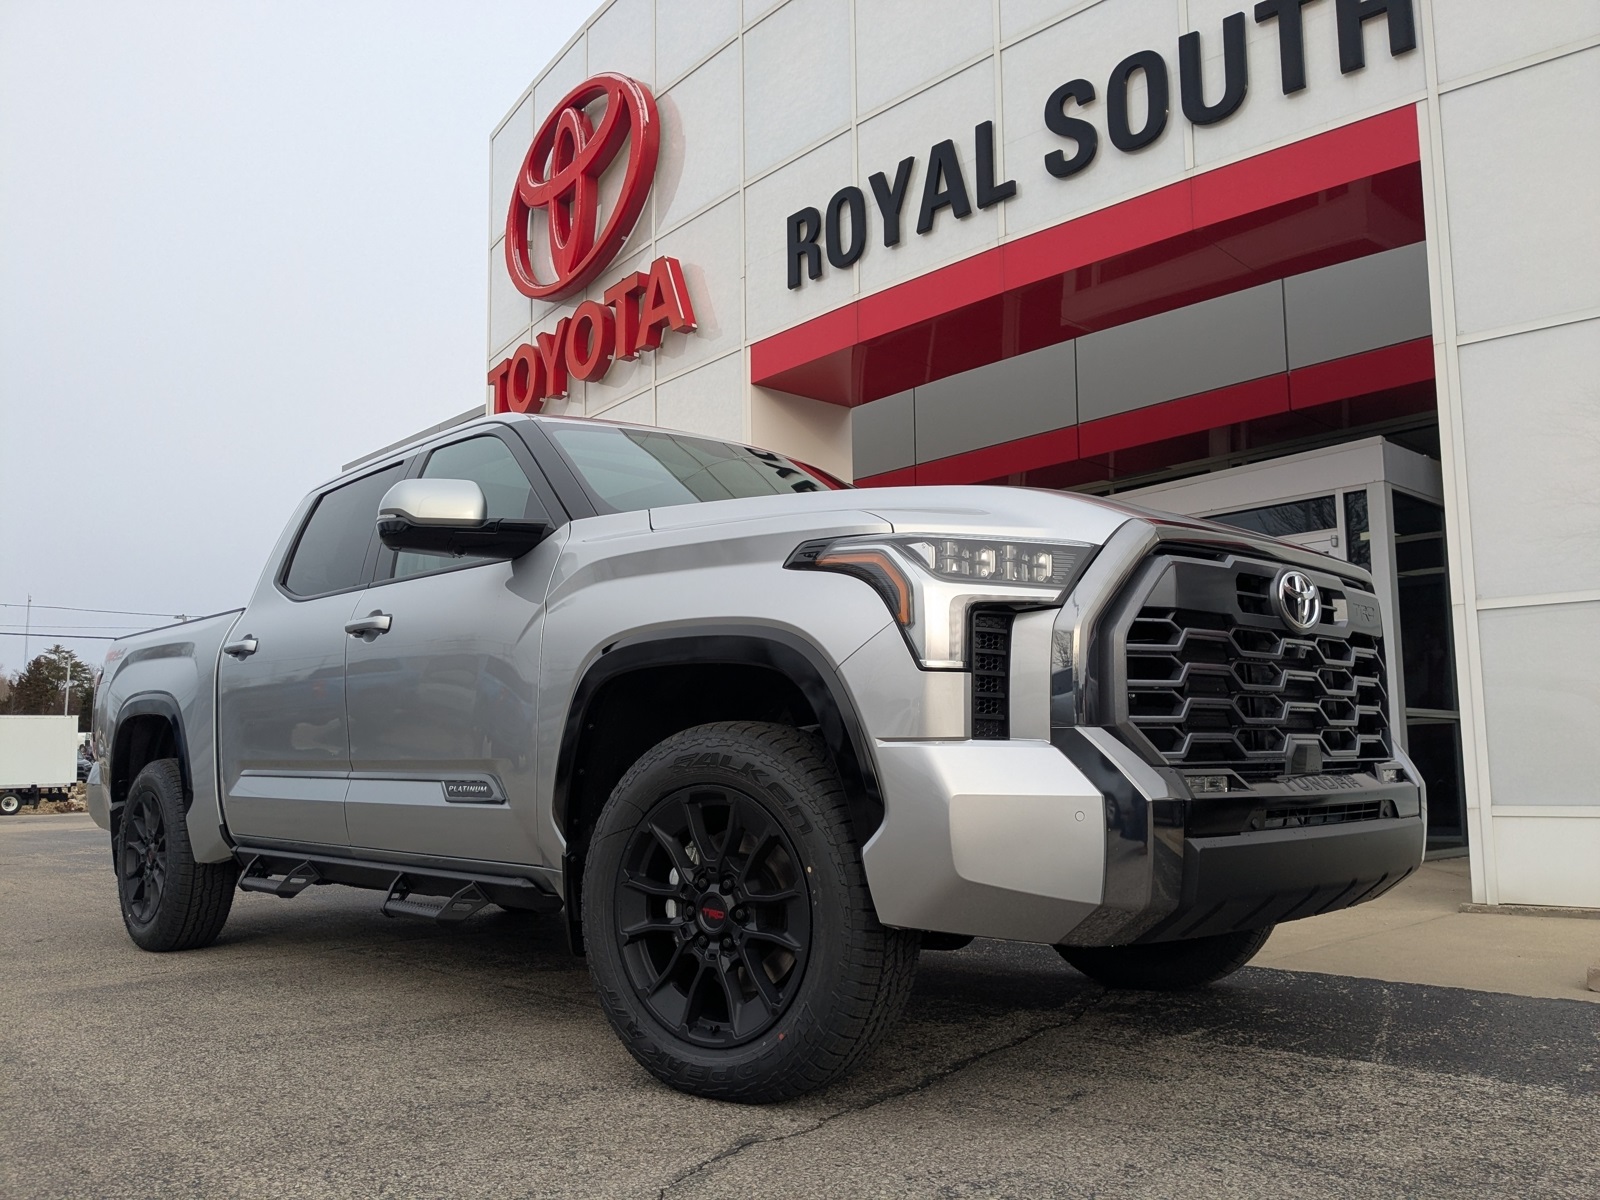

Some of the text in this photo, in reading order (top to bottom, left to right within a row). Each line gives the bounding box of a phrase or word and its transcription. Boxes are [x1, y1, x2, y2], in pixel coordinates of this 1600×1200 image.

[787, 0, 1416, 290] ROYAL SOUTH
[488, 255, 698, 414] TOYOTA
[448, 785, 488, 793] PLATINUM
